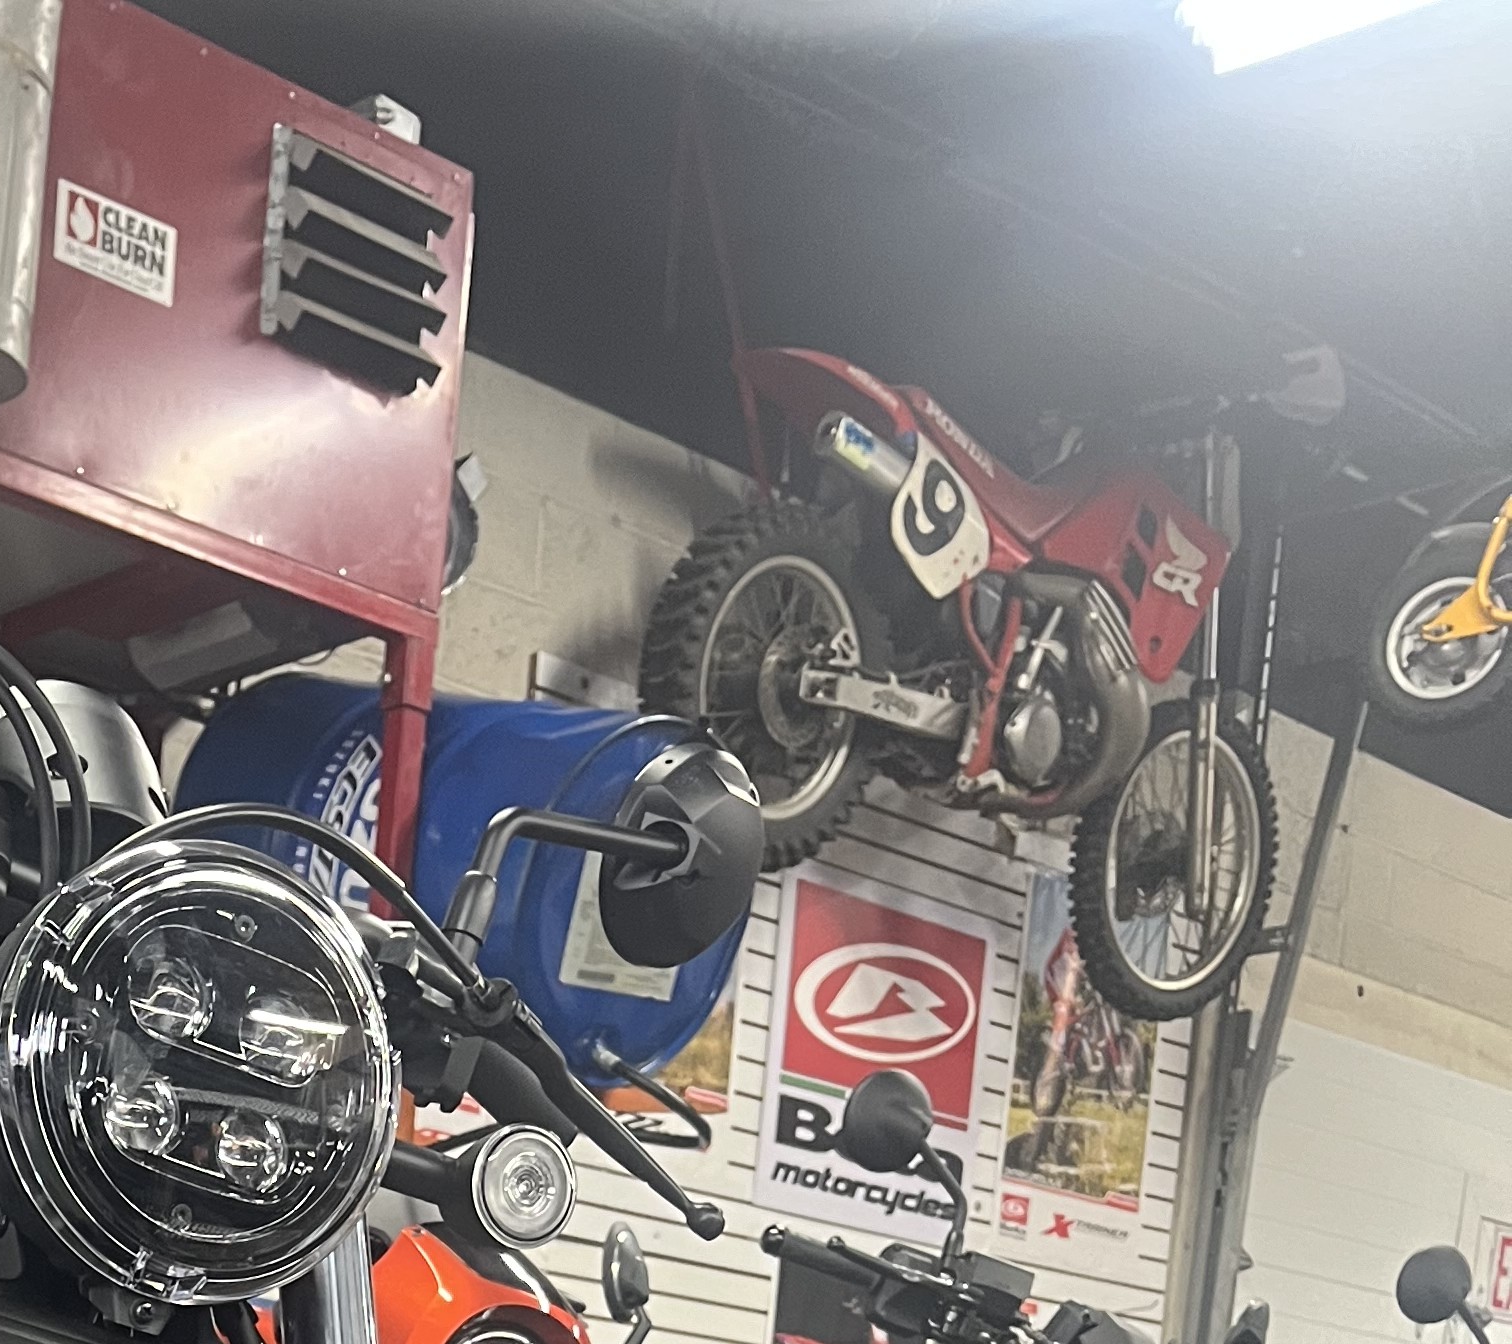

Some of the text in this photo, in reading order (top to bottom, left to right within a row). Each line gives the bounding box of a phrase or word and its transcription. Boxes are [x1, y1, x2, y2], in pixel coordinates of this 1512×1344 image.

[103, 205, 168, 253] CLEAN
[102, 230, 166, 277] BURN
[771, 1161, 957, 1221] motorcycles
